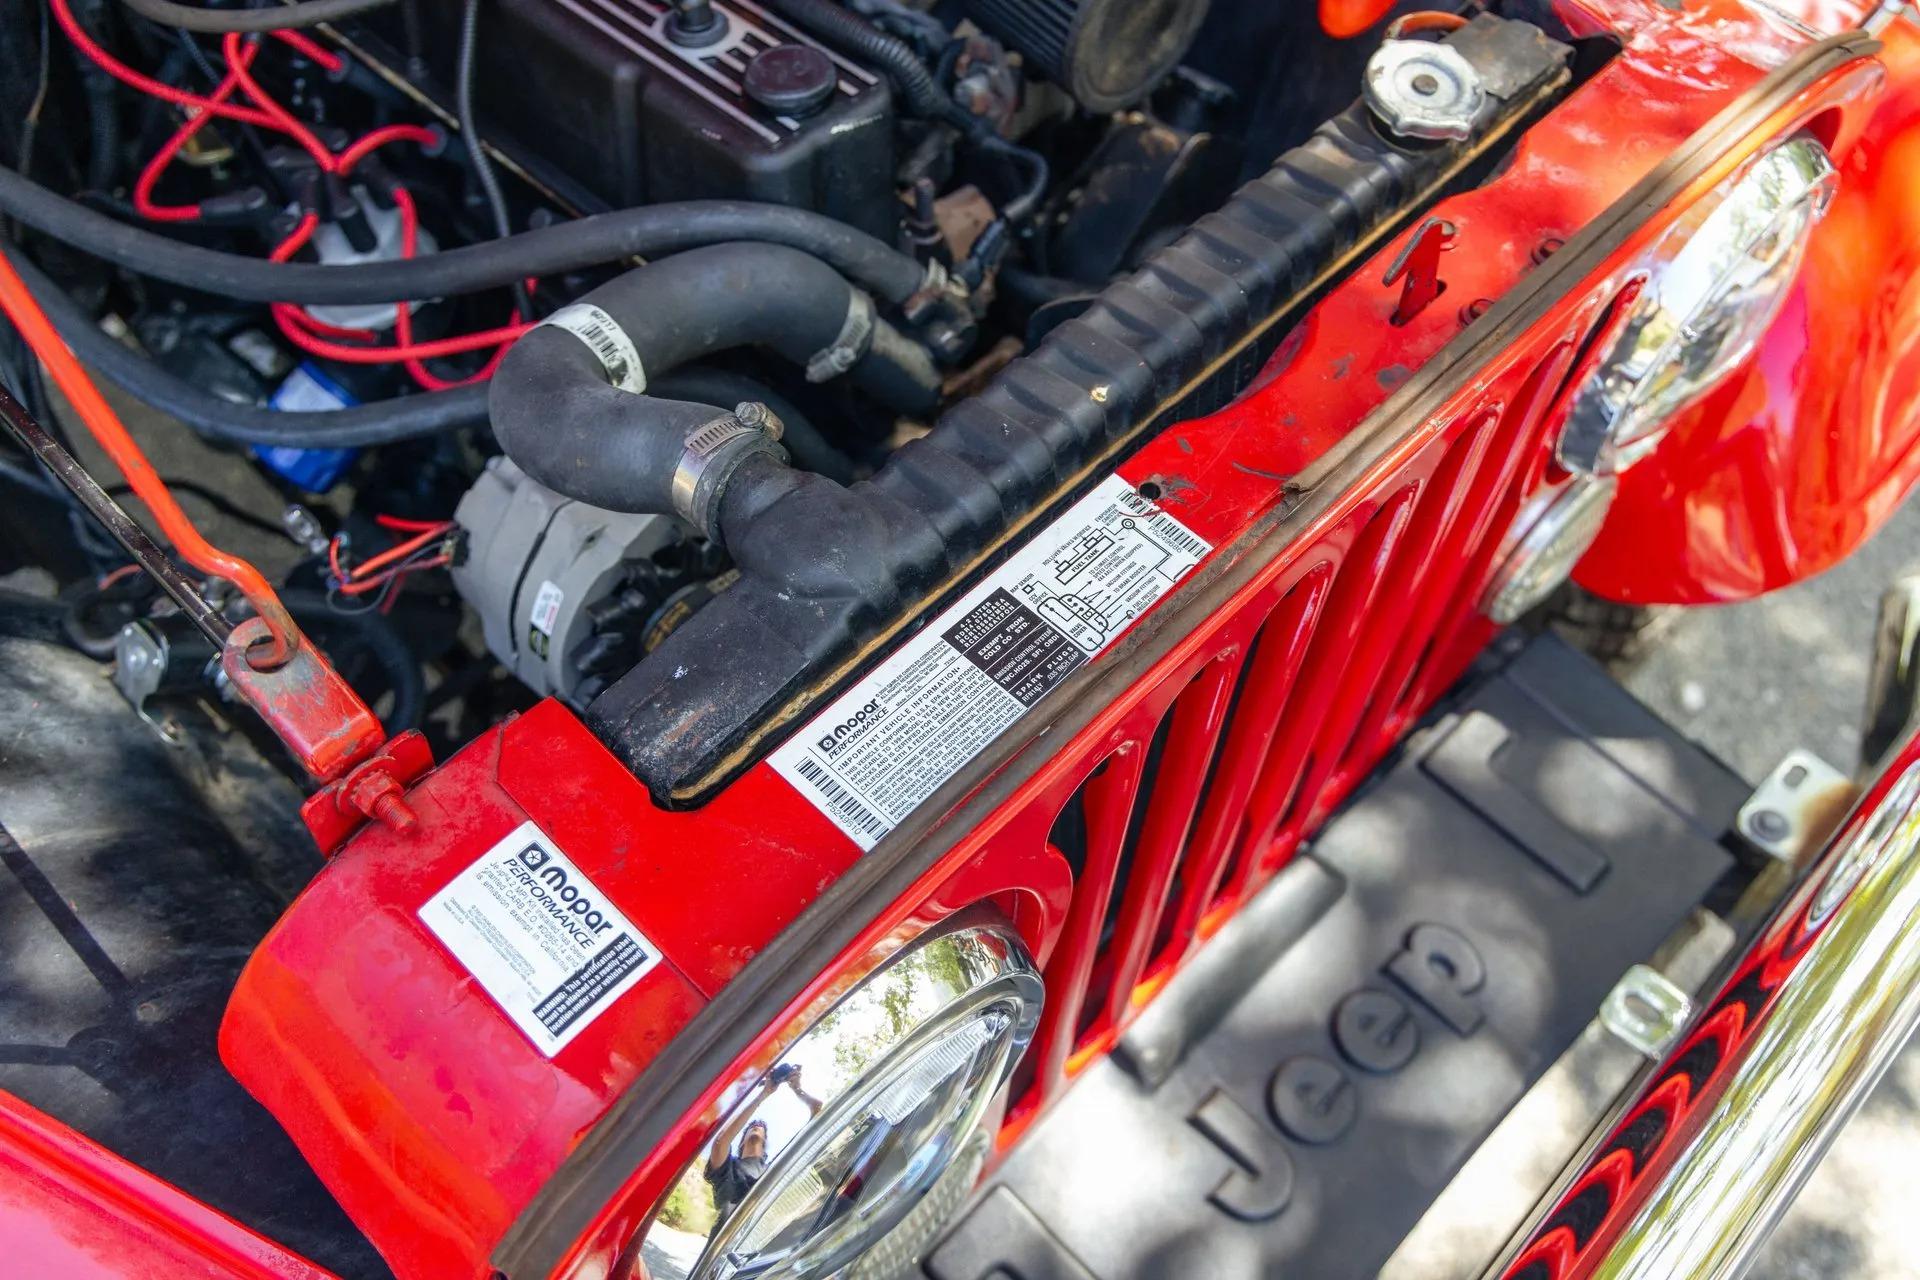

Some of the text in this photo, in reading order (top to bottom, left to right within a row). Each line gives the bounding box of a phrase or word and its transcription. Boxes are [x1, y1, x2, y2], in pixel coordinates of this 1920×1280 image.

[1070, 548, 1100, 572] FUEL TANK
[959, 601, 991, 629] 4.2 LITER
[977, 615, 1025, 656] EXEMPT FROM
[982, 620, 1030, 660] COLD CO STD.
[993, 628, 1053, 680] EMISSION CONTROL SYSTEM
[1015, 645, 1074, 697] SPARK PLUGS
[1055, 659, 1070, 672] INCH
[1067, 650, 1081, 662] GAP
[826, 706, 890, 760] PERFORMANCE
[844, 664, 976, 777] THIS VEHICLE CONFORMS TO U.S.A. EPA REGULATIONS
[849, 668, 981, 782] APPLICABLE TO 1994 MODEL YEAR NEW LIGHT DUTY
[854, 766, 877, 786] TRUCKS
[875, 756, 889, 768] AND
[893, 728, 921, 752] CERTIFIED
[919, 719, 933, 730] FOR
[931, 707, 946, 720] SALE
[950, 692, 963, 704] THE
[961, 679, 979, 694] STATE
[976, 673, 986, 681] OF
[859, 762, 893, 791] CALIFORNIA
[891, 749, 907, 763] WITH
[912, 724, 937, 746] FEDERAL
[965, 677, 992, 700] CONTROL
[871, 685, 999, 796] BASIC IGNITION TIMING AND IDLE FUEL/AIR MIXTURE HAVE BEEN
[879, 707, 911, 735] VEHICLE
[878, 776, 913, 807] PROCEDURES
[913, 765, 925, 776] AND
[925, 750, 943, 766] OTHER
[943, 724, 973, 750] ADDITIONAL
[886, 778, 921, 808] ADJUSTMENTS
[919, 766, 935, 779] MADE
[940, 746, 958, 761] OTHER
[956, 735, 971, 747] THAN
[969, 714, 994, 736] APPROVED
[993, 697, 1013, 715] SERVICE
[888, 797, 908, 815] MANUAL
[907, 774, 935, 799] PROCEDURE
[933, 766, 944, 776] MAY
[943, 750, 962, 767] VIOLATE
[960, 733, 982, 752] FEDERAL
[980, 724, 992, 735] AND
[990, 713, 1005, 726] STATE
[916, 785, 932, 800] APPLY
[930, 768, 952, 787] PARKING
[950, 754, 968, 770] BRAKE
[965, 743, 981, 756] WHEN
[979, 722, 1004, 744] SERVICING
[481, 880, 511, 909] emission
[501, 855, 595, 951] PERFORMANCE
[503, 889, 525, 910] CARB
[513, 885, 528, 900] MPI
[542, 1009, 559, 1026] must
[556, 1002, 567, 1013] be
[563, 982, 590, 1007] attached
[587, 976, 597, 986] in
[597, 957, 619, 977] readily
[616, 941, 637, 961] visible
[565, 977, 582, 993] This
[579, 948, 616, 982] certification
[613, 934, 632, 952] label
[548, 1009, 574, 1033] location
[571, 994, 591, 1013] under
[587, 983, 603, 998] your
[1186, 921, 1488, 1225] Jeep
